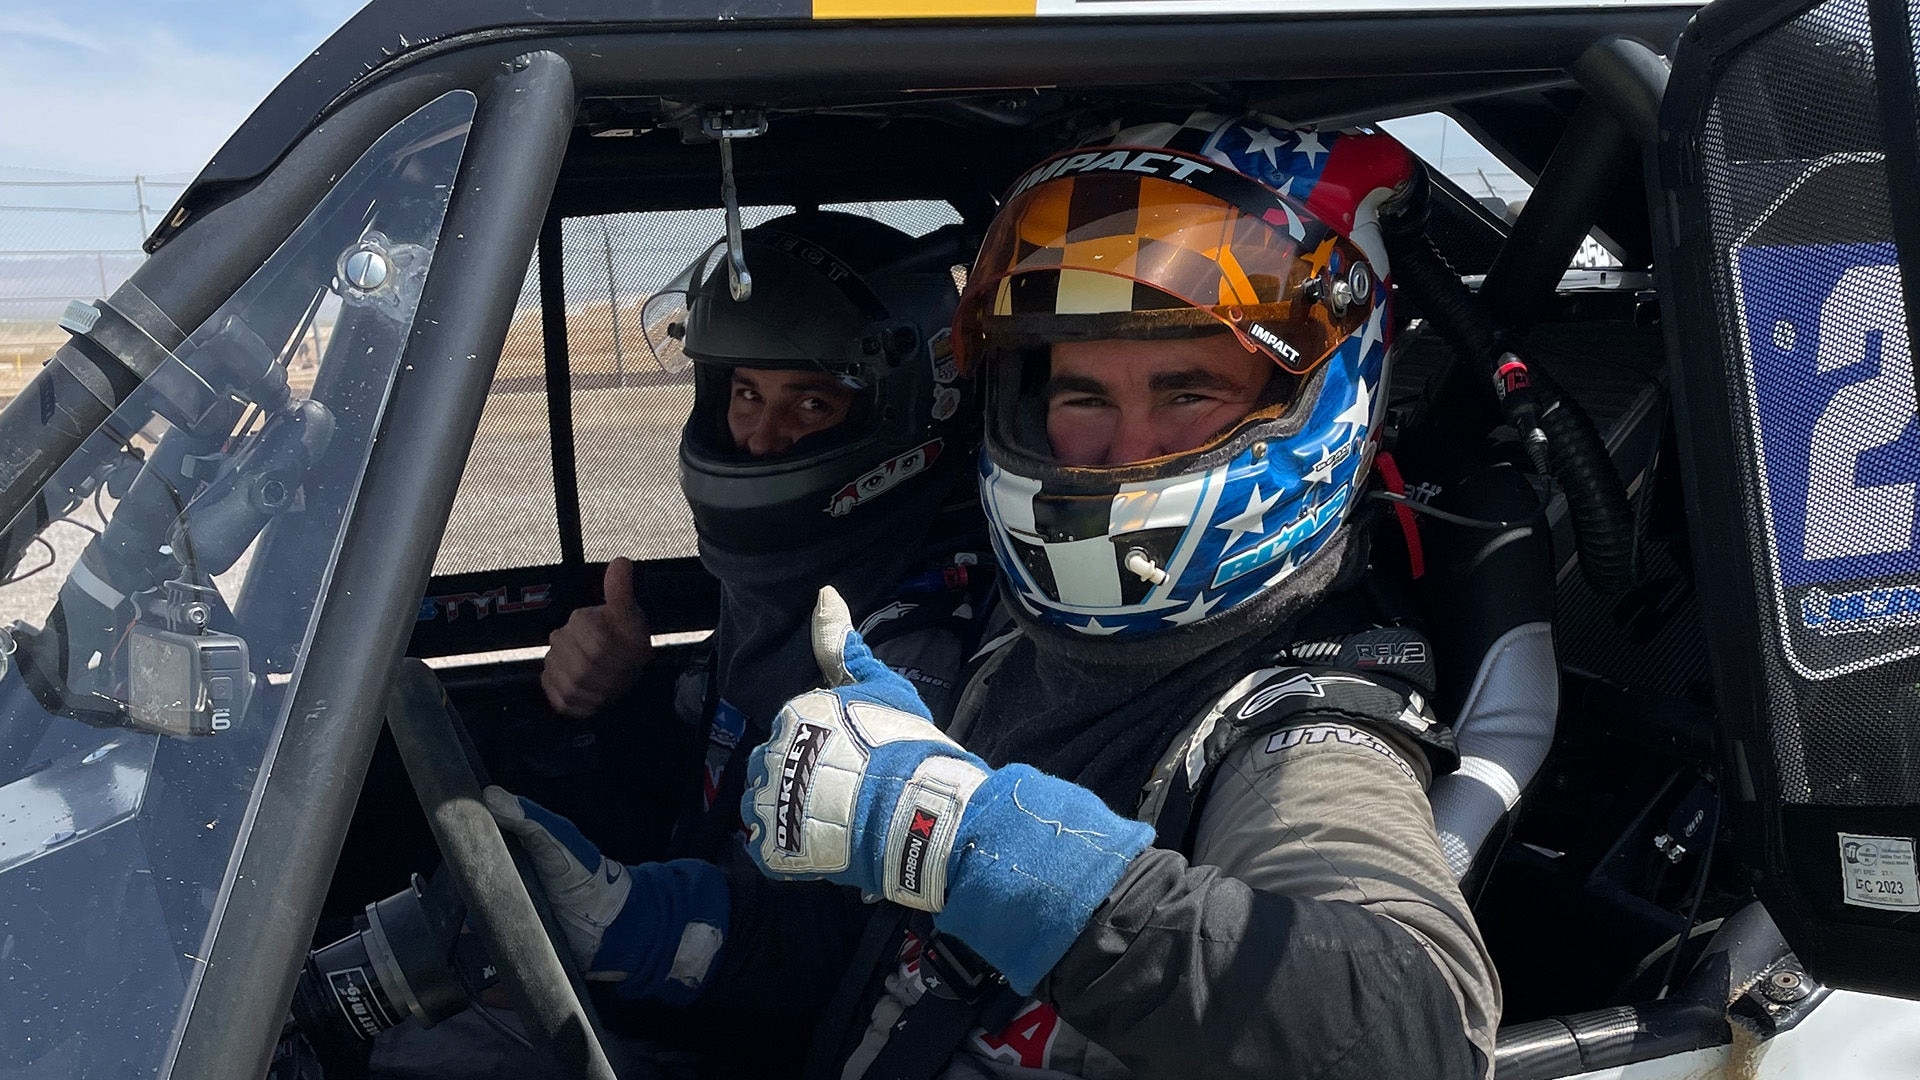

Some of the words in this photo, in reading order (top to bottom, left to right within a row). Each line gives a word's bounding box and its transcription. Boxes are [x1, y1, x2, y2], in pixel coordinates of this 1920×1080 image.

[1008, 150, 1213, 202] IMPACT
[1250, 323, 1300, 361] IMPACT
[1803, 264, 1917, 562] 2
[1376, 656, 1410, 665] LITE
[211, 712, 231, 730] 6
[776, 724, 813, 848] OAKLEY
[904, 838, 923, 890] CARBON
[1876, 880, 1904, 895] 2023
